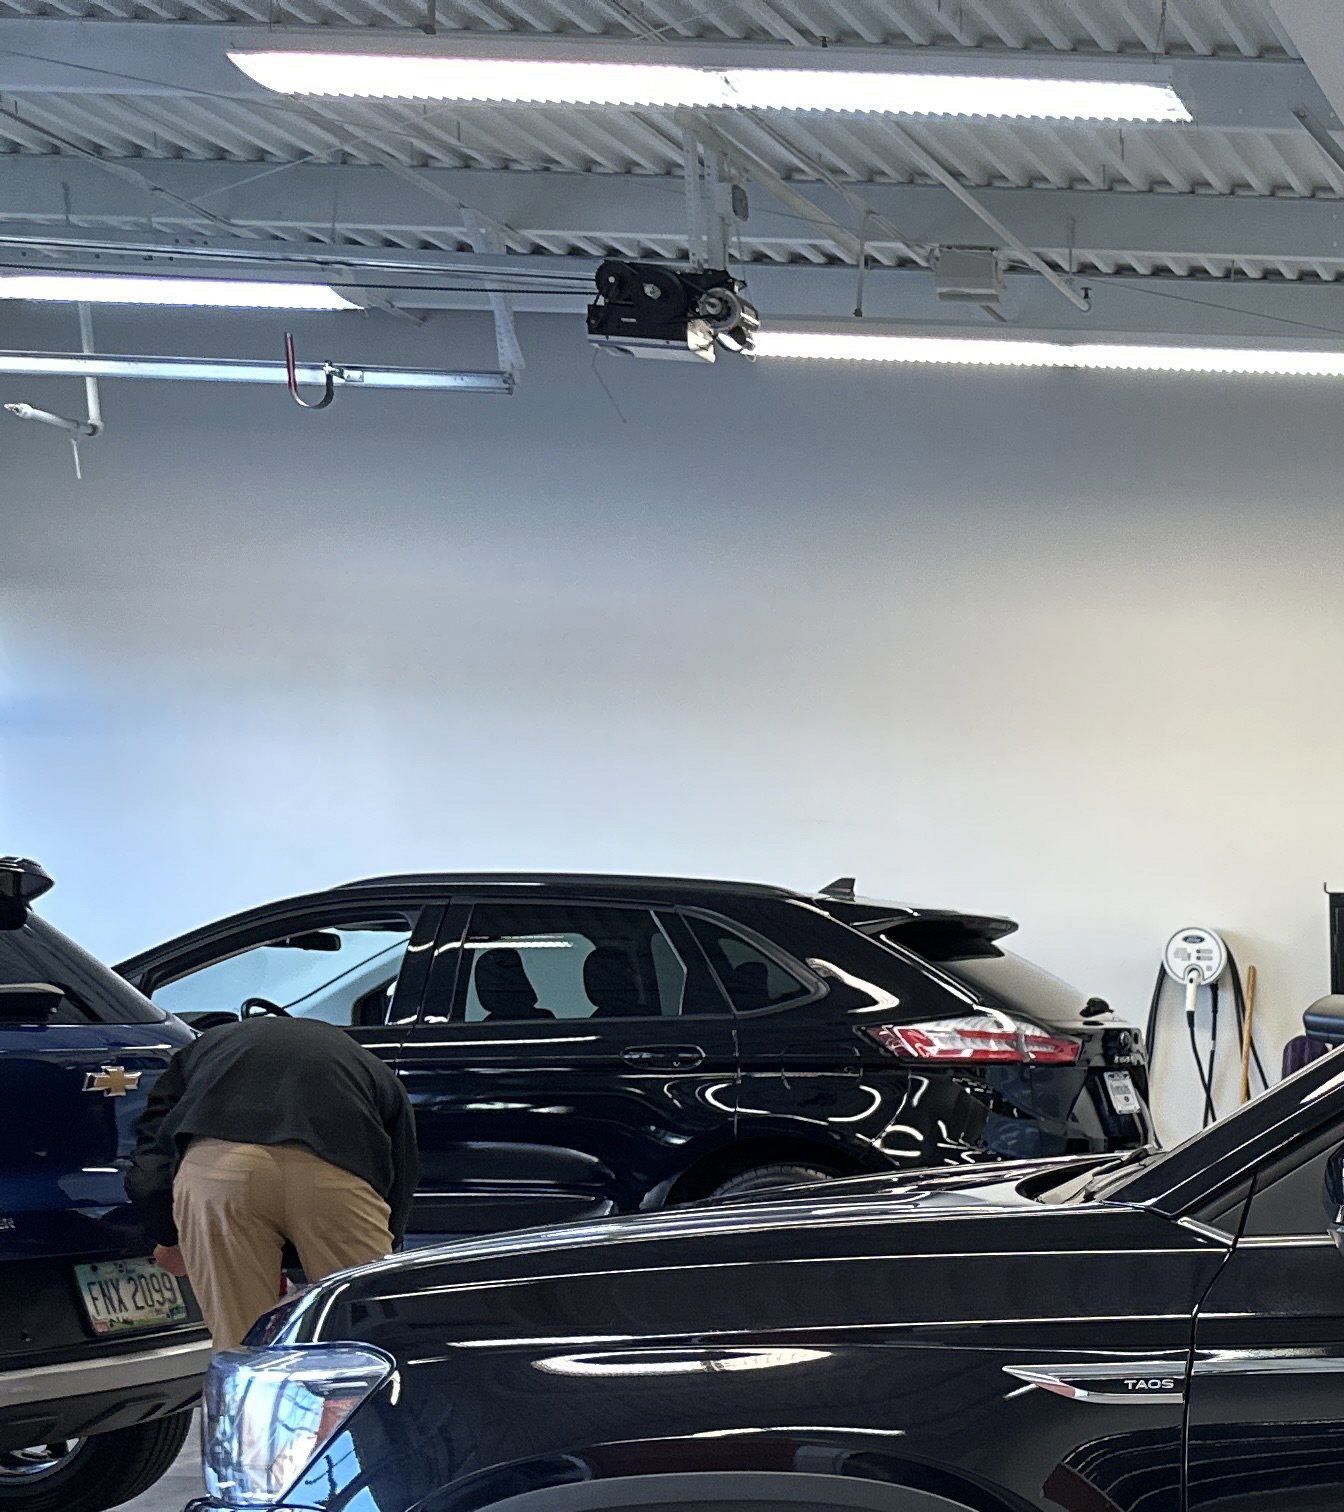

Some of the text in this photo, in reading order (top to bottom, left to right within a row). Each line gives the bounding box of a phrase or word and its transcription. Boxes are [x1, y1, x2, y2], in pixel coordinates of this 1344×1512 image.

[87, 1272, 178, 1316] FNX 2099
[1123, 1379, 1175, 1390] TAOS
